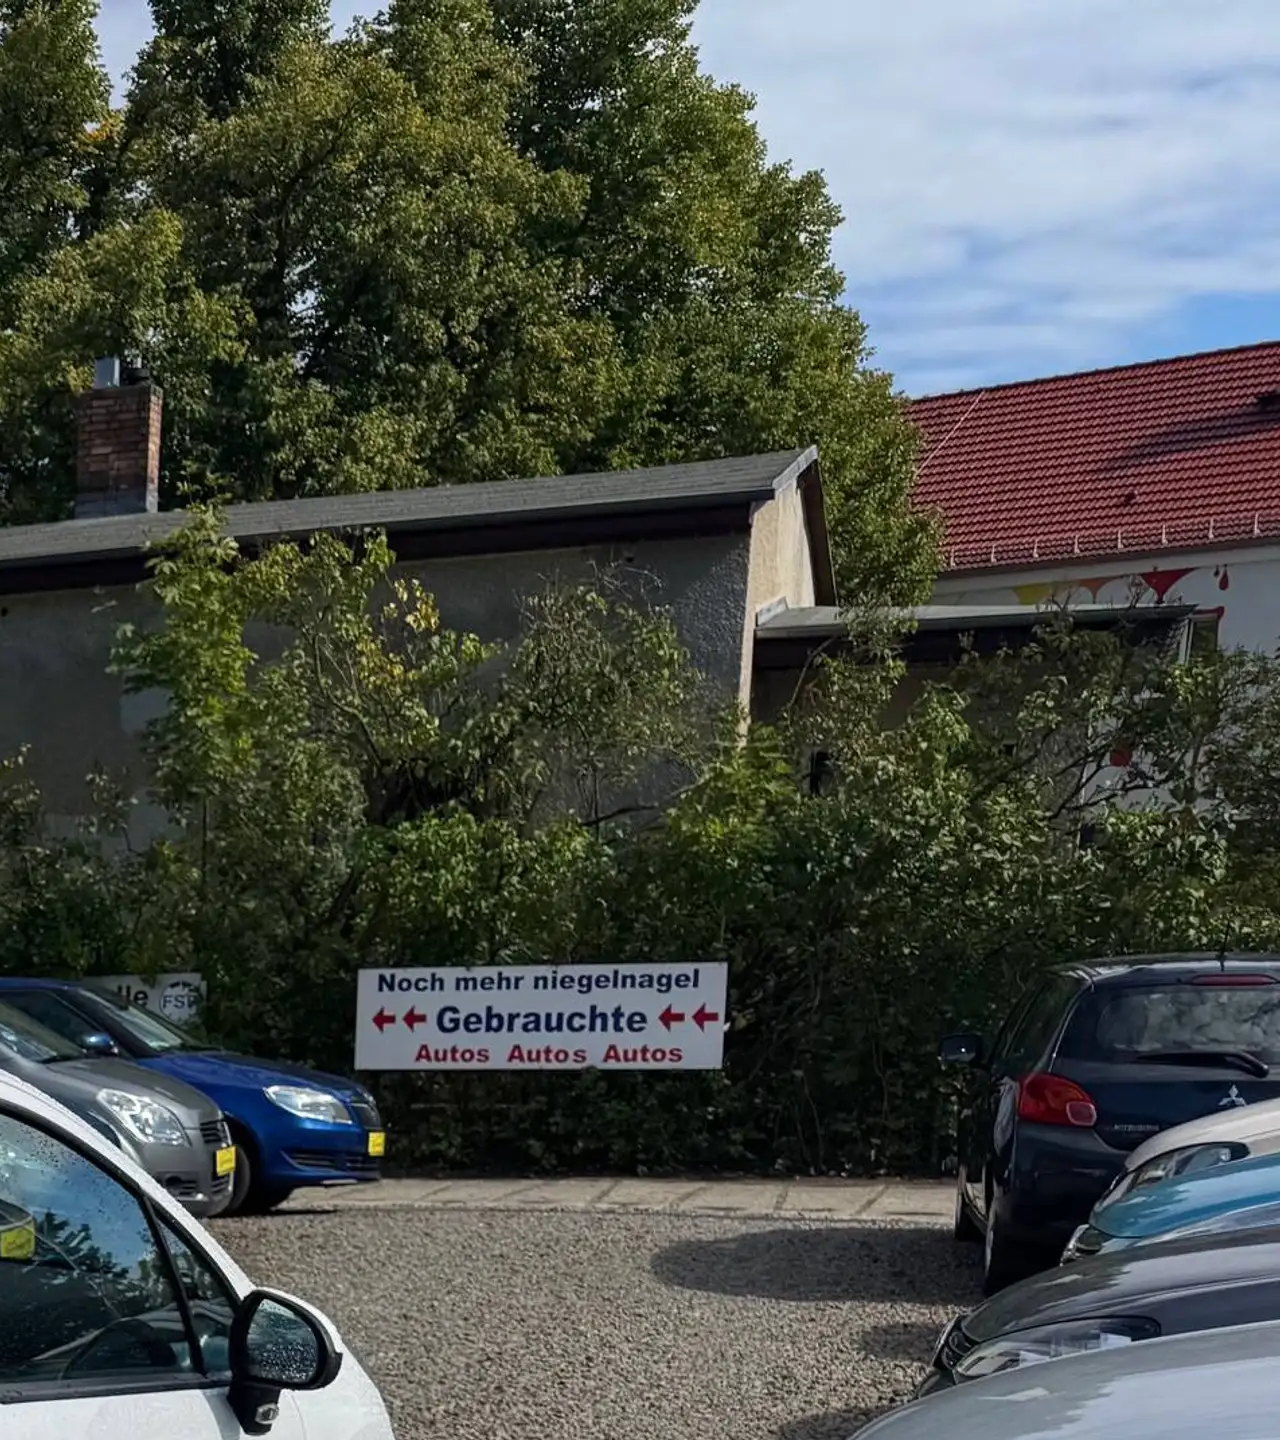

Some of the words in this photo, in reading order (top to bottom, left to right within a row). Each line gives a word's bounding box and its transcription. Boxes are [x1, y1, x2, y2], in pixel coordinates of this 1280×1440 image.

[378, 972, 445, 993] Noch
[455, 972, 525, 991] mehr
[533, 968, 700, 995] niegelnagel
[436, 1005, 648, 1034] Gebrauchte
[415, 1043, 490, 1064] Autos
[507, 1043, 587, 1064] Autos
[603, 1043, 683, 1063] Autos
